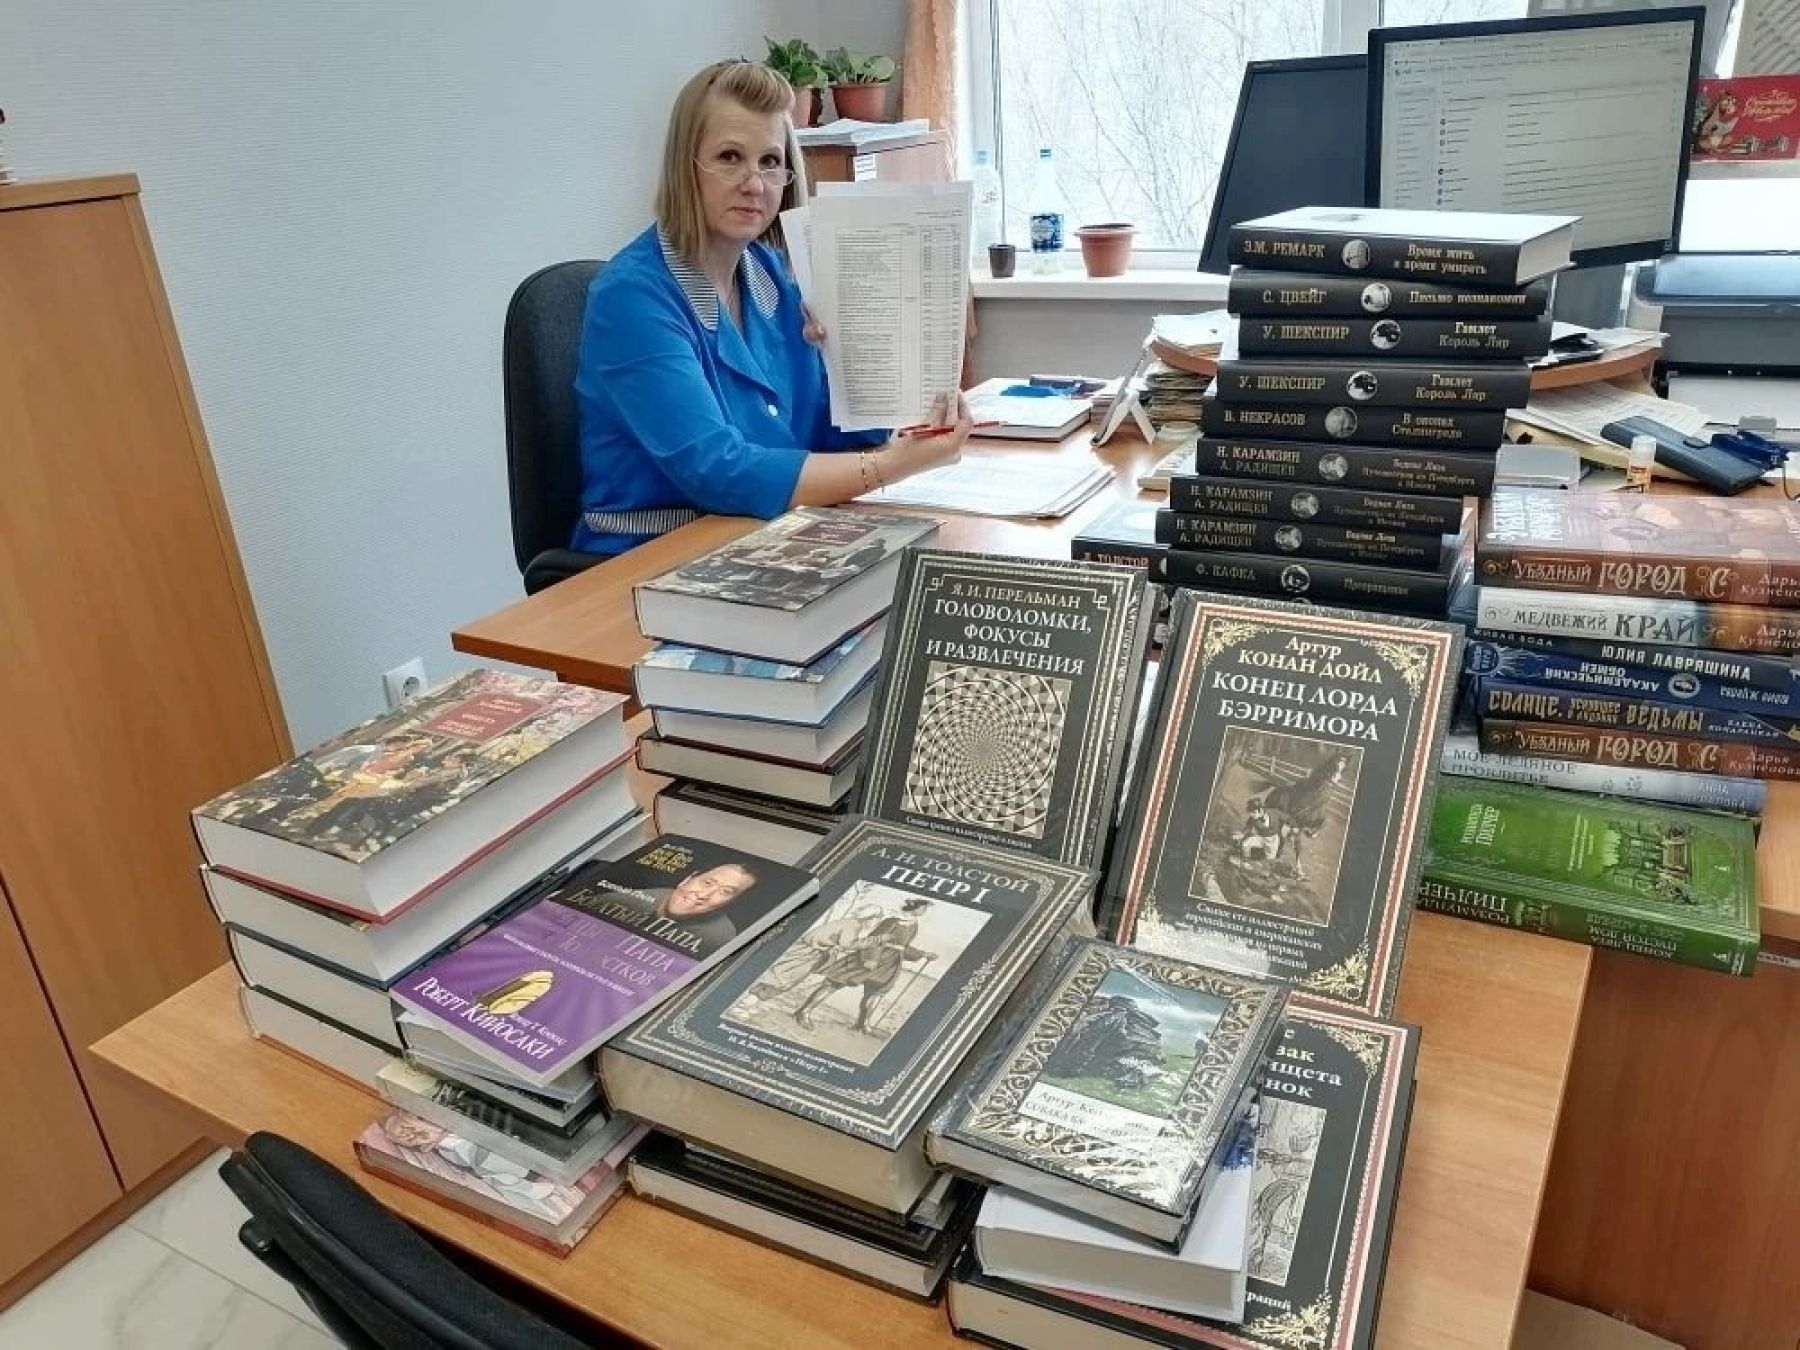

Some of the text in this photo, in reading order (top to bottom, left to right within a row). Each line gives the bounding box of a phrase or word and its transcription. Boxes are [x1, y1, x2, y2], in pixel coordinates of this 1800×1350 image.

[1273, 241, 1326, 258] РЕМАРК
[1263, 287, 1327, 307] С. ЦВЕЙГ
[1409, 291, 1453, 304] Письмо
[1262, 325, 1350, 340] У. ШЕКСПИР
[1455, 321, 1497, 334] Гамлет
[1440, 334, 1510, 350] Король Лир
[1239, 376, 1326, 390] У. ШЕКСПИР
[1432, 373, 1473, 387] Гамлет
[1415, 386, 1486, 402] Король Лир
[1240, 411, 1307, 426] НЕКРАСОВ
[1232, 446, 1301, 464] КАРАМЗИН
[1236, 461, 1296, 476] РАДИЩЕВ
[1205, 486, 1274, 503] КАРАМЗИН
[1209, 500, 1269, 515] РАДИЩЕВ
[1191, 518, 1257, 536] КАРАМЗИН
[1194, 534, 1253, 548] РАДИЩЕВ
[1212, 564, 1256, 581] КАФКА
[1597, 562, 1687, 596] ГОРОД
[951, 583, 1081, 609] Я. И. ПЕРЕЛЬМАН
[934, 599, 1092, 634] ГОЛОВОЛОМКИ,
[1513, 609, 1695, 643] МЕДВЕЖИЙ КРАЙ
[964, 623, 1053, 649] ФОКУСЫ
[1518, 635, 1553, 647] ВОДА
[925, 639, 1086, 676] И РАЗВЛЕЧЕНИЯ
[1284, 636, 1342, 661] Артур
[1238, 649, 1383, 685] КОНАН ДОЙЛ
[1580, 661, 1626, 679] ОБМЕН
[1601, 646, 1751, 682] ЮЛИЯ ЛАВРЯШИНА
[1545, 667, 1660, 692] АКАДЕМИЧЕСКИЙ
[1211, 670, 1398, 717] КОНЕЦ ЛОРДА
[1217, 698, 1380, 742] БЭРРИМОРА
[1626, 704, 1704, 732] ВЕДЬМЫ
[1597, 735, 1679, 768] ГОРОД
[880, 865, 971, 897] ПЕТР
[894, 851, 916, 865] Н.
[923, 857, 1031, 894] ТОЛСТОЙ
[1418, 881, 1508, 912] ПИЛЧЕР
[644, 916, 703, 953] ПАПА
[613, 935, 676, 972] ПАПА
